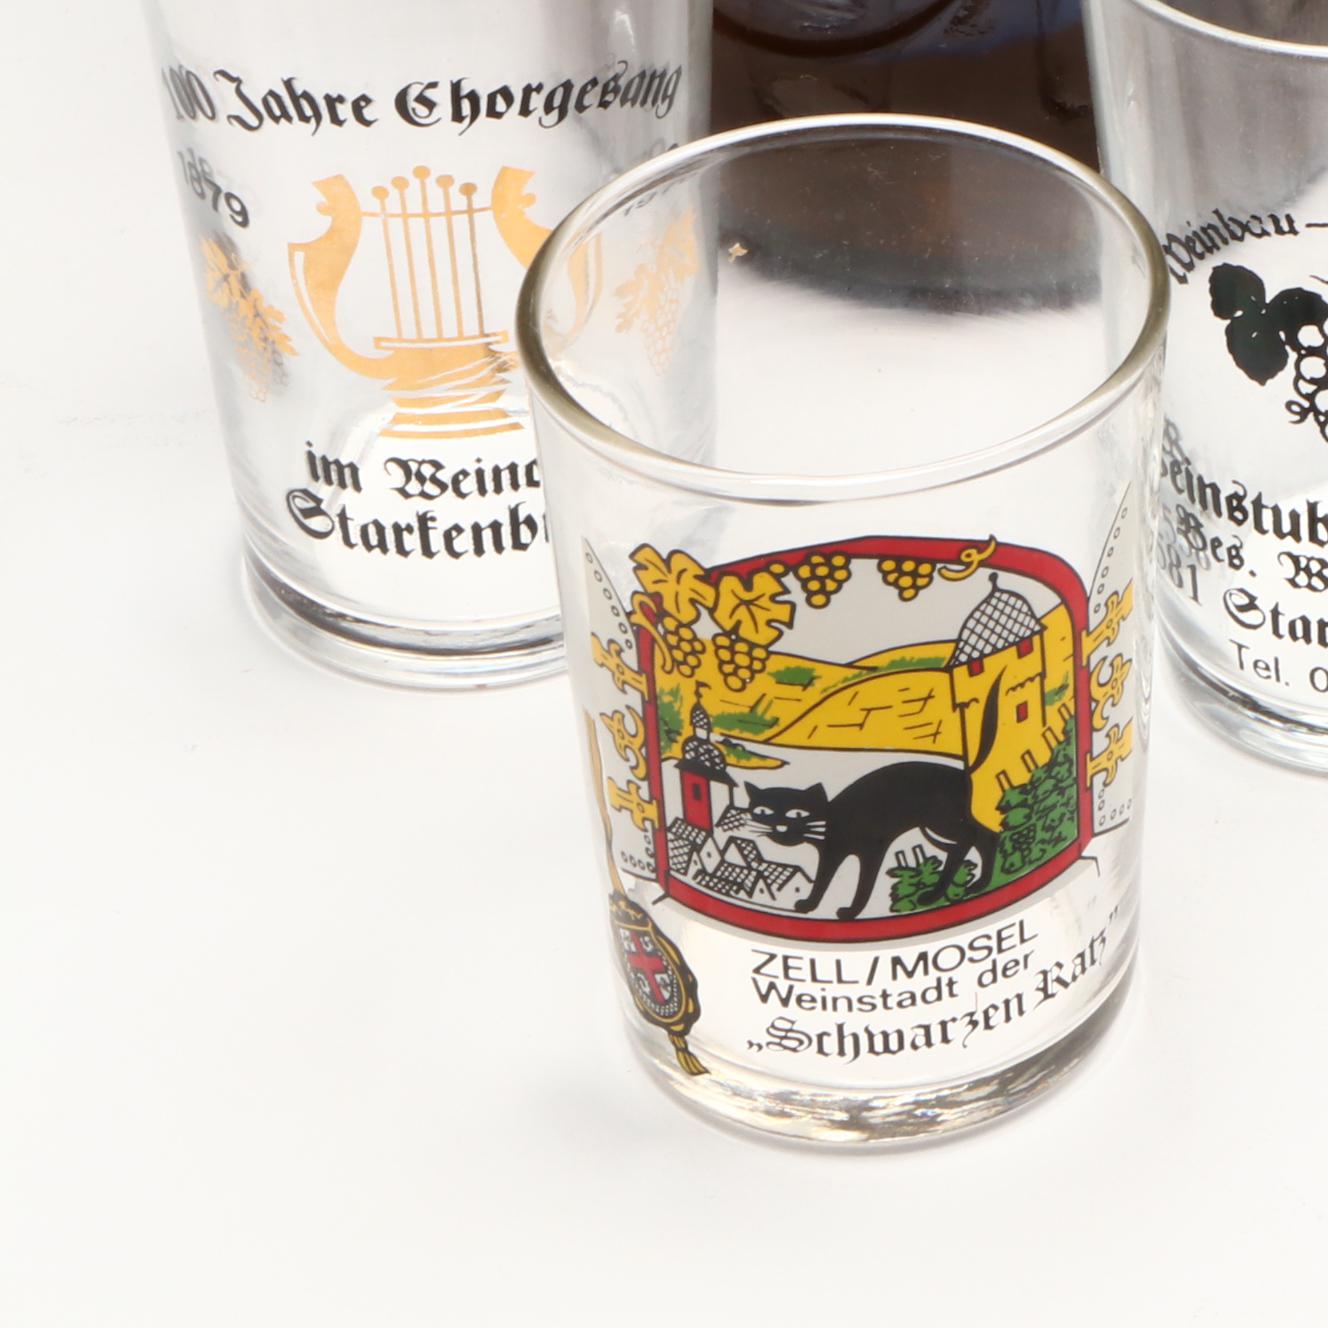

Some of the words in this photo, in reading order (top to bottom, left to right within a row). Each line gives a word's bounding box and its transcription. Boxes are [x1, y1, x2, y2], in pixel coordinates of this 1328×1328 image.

[213, 68, 379, 136] Jahre
[394, 59, 683, 137] Chorgesang
[304, 440, 363, 494] im
[1229, 640, 1290, 687] Tel.
[751, 975, 959, 1013] Weinstadt
[976, 950, 1036, 990] der
